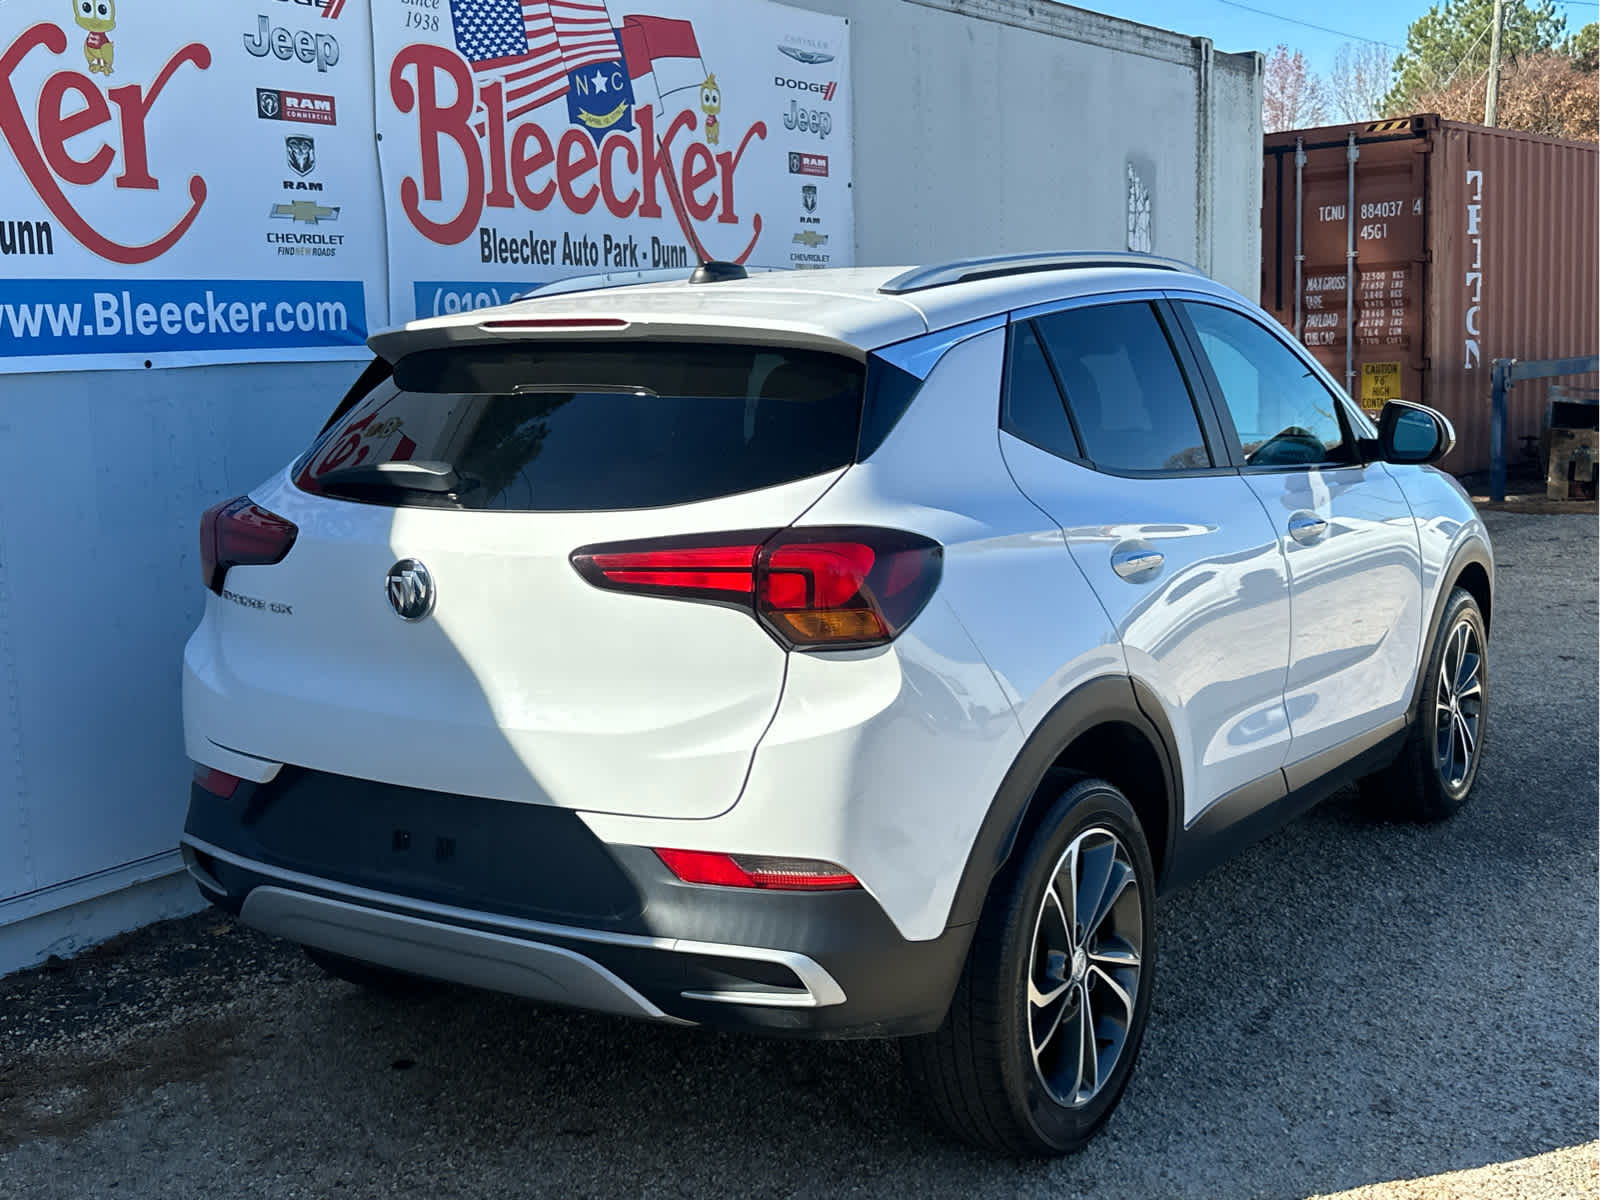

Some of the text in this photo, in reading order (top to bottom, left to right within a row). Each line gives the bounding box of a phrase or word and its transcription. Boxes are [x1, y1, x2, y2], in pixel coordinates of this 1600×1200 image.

[406, 11, 439, 32] 1938
[243, 15, 340, 72] Jeep
[774, 77, 828, 93] DODGE
[285, 96, 331, 111] RAM
[286, 110, 332, 120] COMMERCIAL
[783, 100, 832, 139] Jeep
[390, 43, 767, 263] Bleecker
[802, 157, 827, 167] RAM
[283, 180, 323, 191] RAM
[1319, 198, 1422, 221] TCNU 884037 4
[800, 216, 821, 224] RAM
[266, 232, 345, 245] CHEVROLET
[1360, 223, 1387, 240] 45G1
[277, 246, 295, 256] FIND
[312, 247, 336, 257] ROADS
[480, 227, 557, 266] Bleecker
[562, 231, 599, 267] Auto
[603, 233, 639, 268] Park
[651, 236, 687, 268] Dunn
[790, 253, 830, 262] CHEVROLET
[1306, 313, 1338, 328] PAYLOAD
